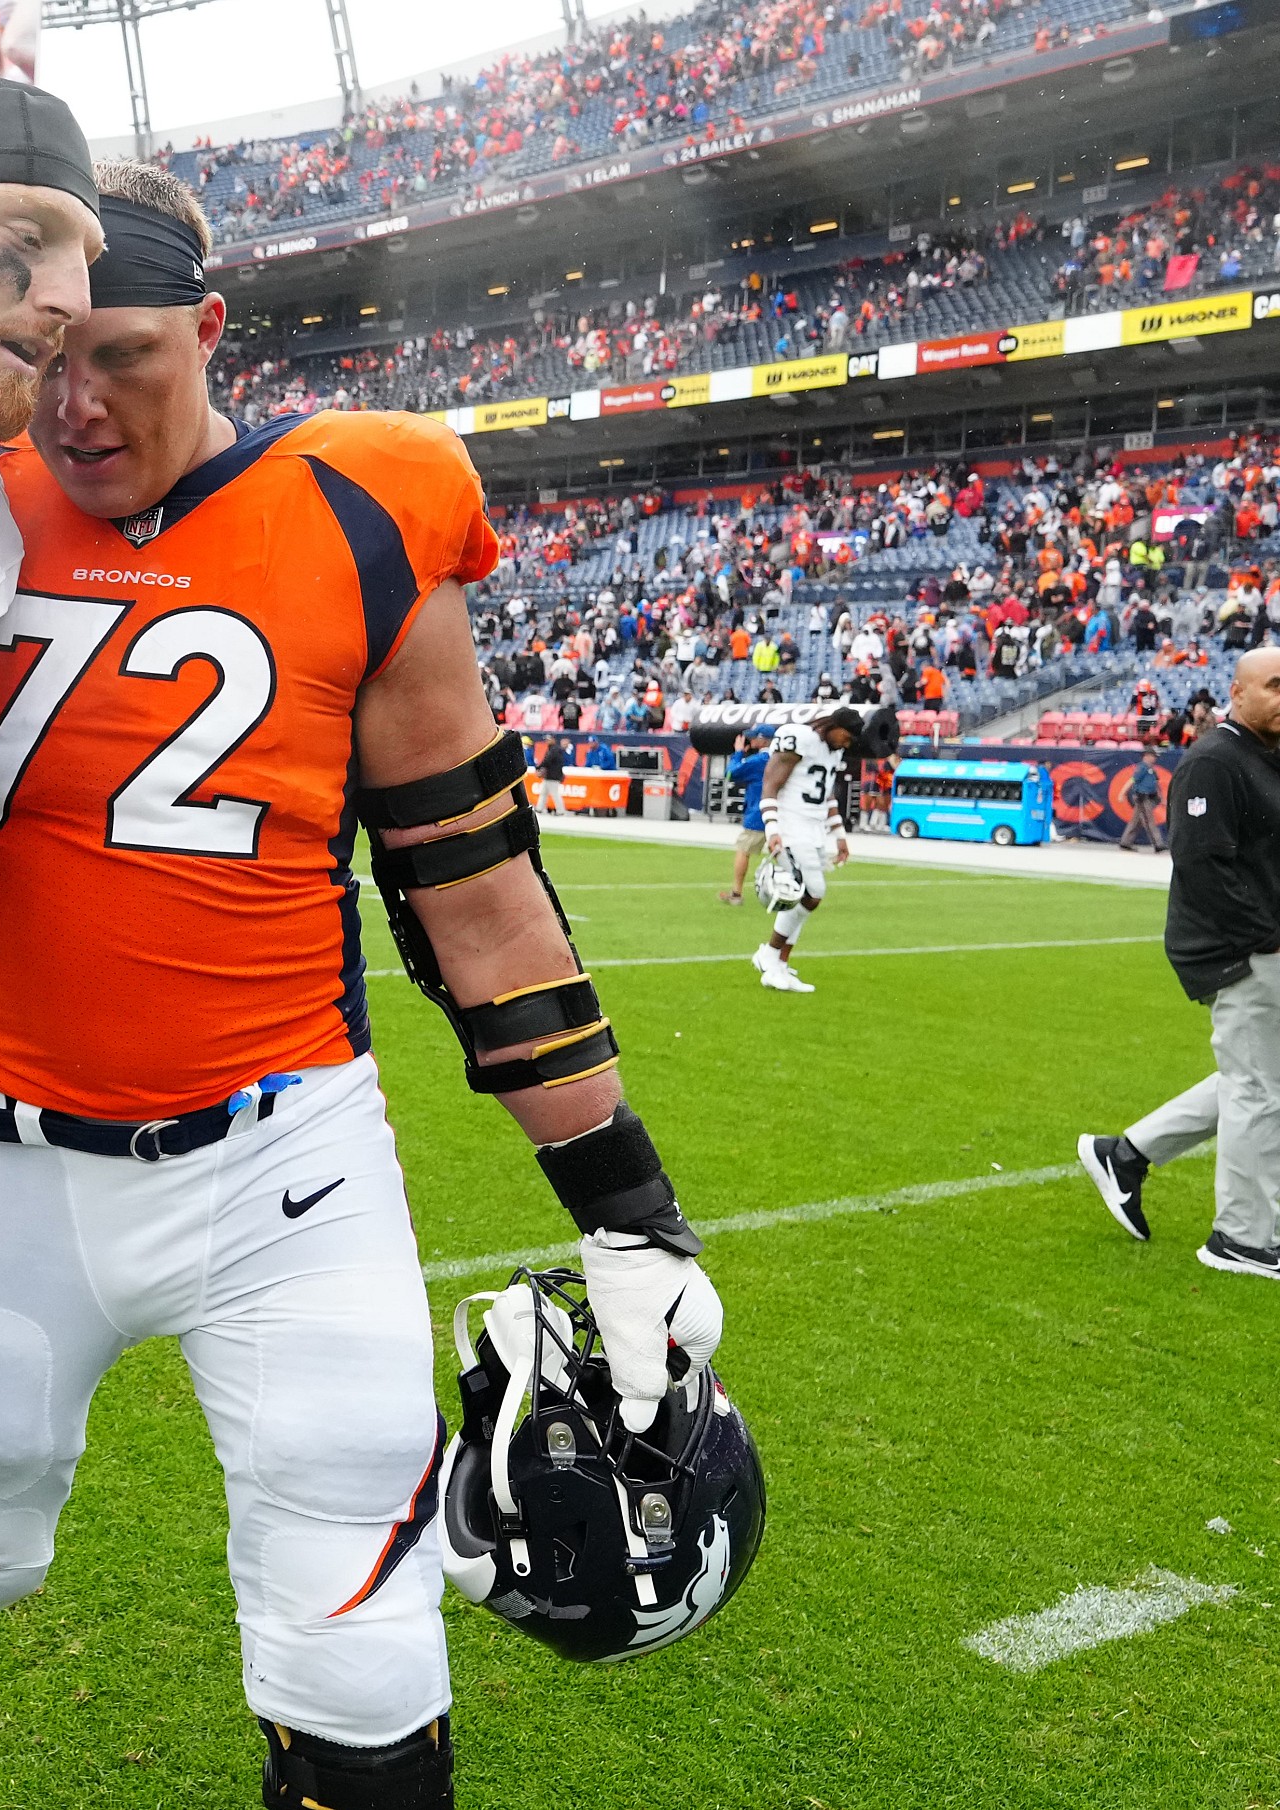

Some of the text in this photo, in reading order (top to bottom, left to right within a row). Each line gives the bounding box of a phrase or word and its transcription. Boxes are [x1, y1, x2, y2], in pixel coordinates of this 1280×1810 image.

[831, 89, 921, 123] SHANAHAN
[699, 132, 755, 157] BAILEY
[594, 162, 631, 183] ELAM
[1254, 295, 1280, 320] CA
[848, 354, 879, 378] CAT
[129, 520, 154, 535] NFL
[72, 568, 192, 589] BRONCOS
